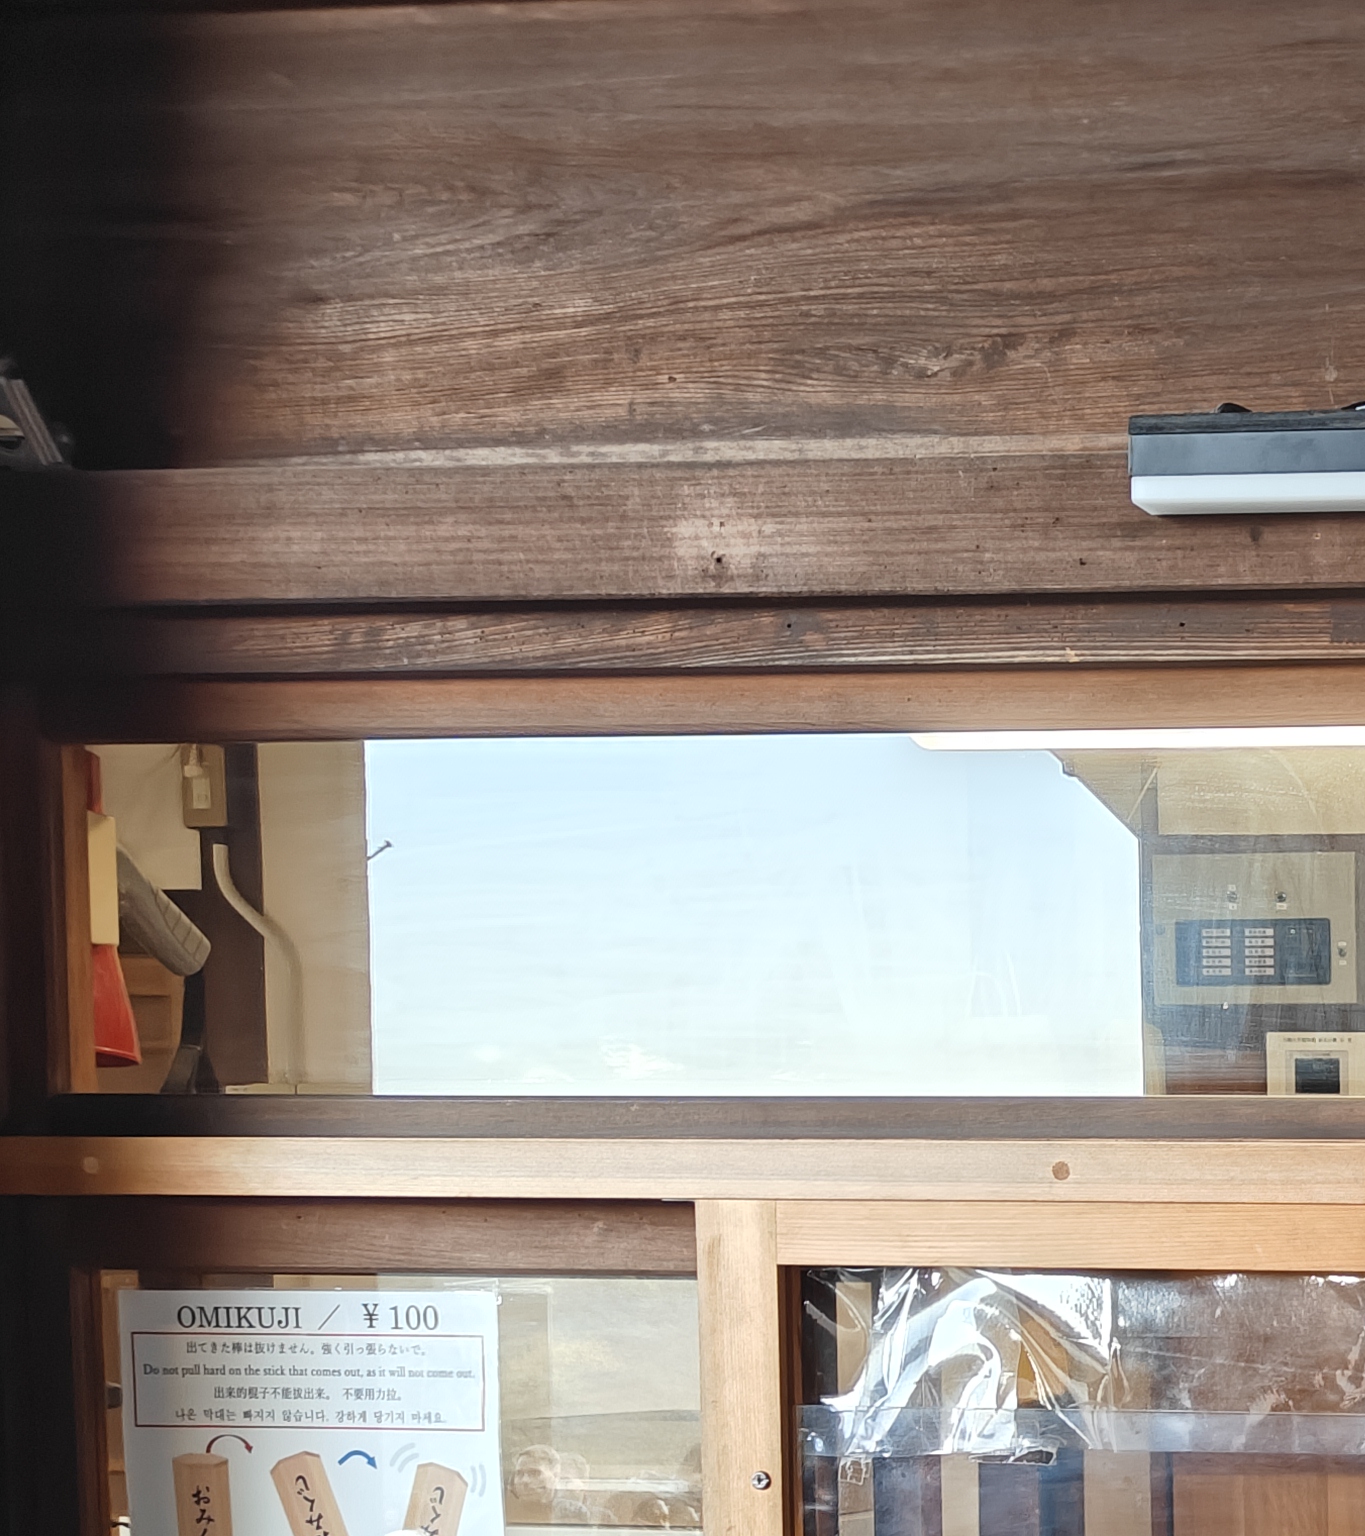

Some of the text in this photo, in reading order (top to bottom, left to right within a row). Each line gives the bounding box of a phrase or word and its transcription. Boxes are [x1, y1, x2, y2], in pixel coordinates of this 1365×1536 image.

[177, 1305, 302, 1330] OMIKUJI
[143, 1363, 160, 1376] Do
[162, 1364, 179, 1376] not
[182, 1364, 200, 1378] pull
[203, 1364, 226, 1376] hard
[228, 1366, 241, 1376] on
[244, 1364, 260, 1376] the
[263, 1364, 286, 1376] stick
[289, 1364, 307, 1376] that
[311, 1367, 341, 1377] comes
[366, 1368, 376, 1377] as
[378, 1366, 386, 1377] it
[388, 1366, 405, 1377] will
